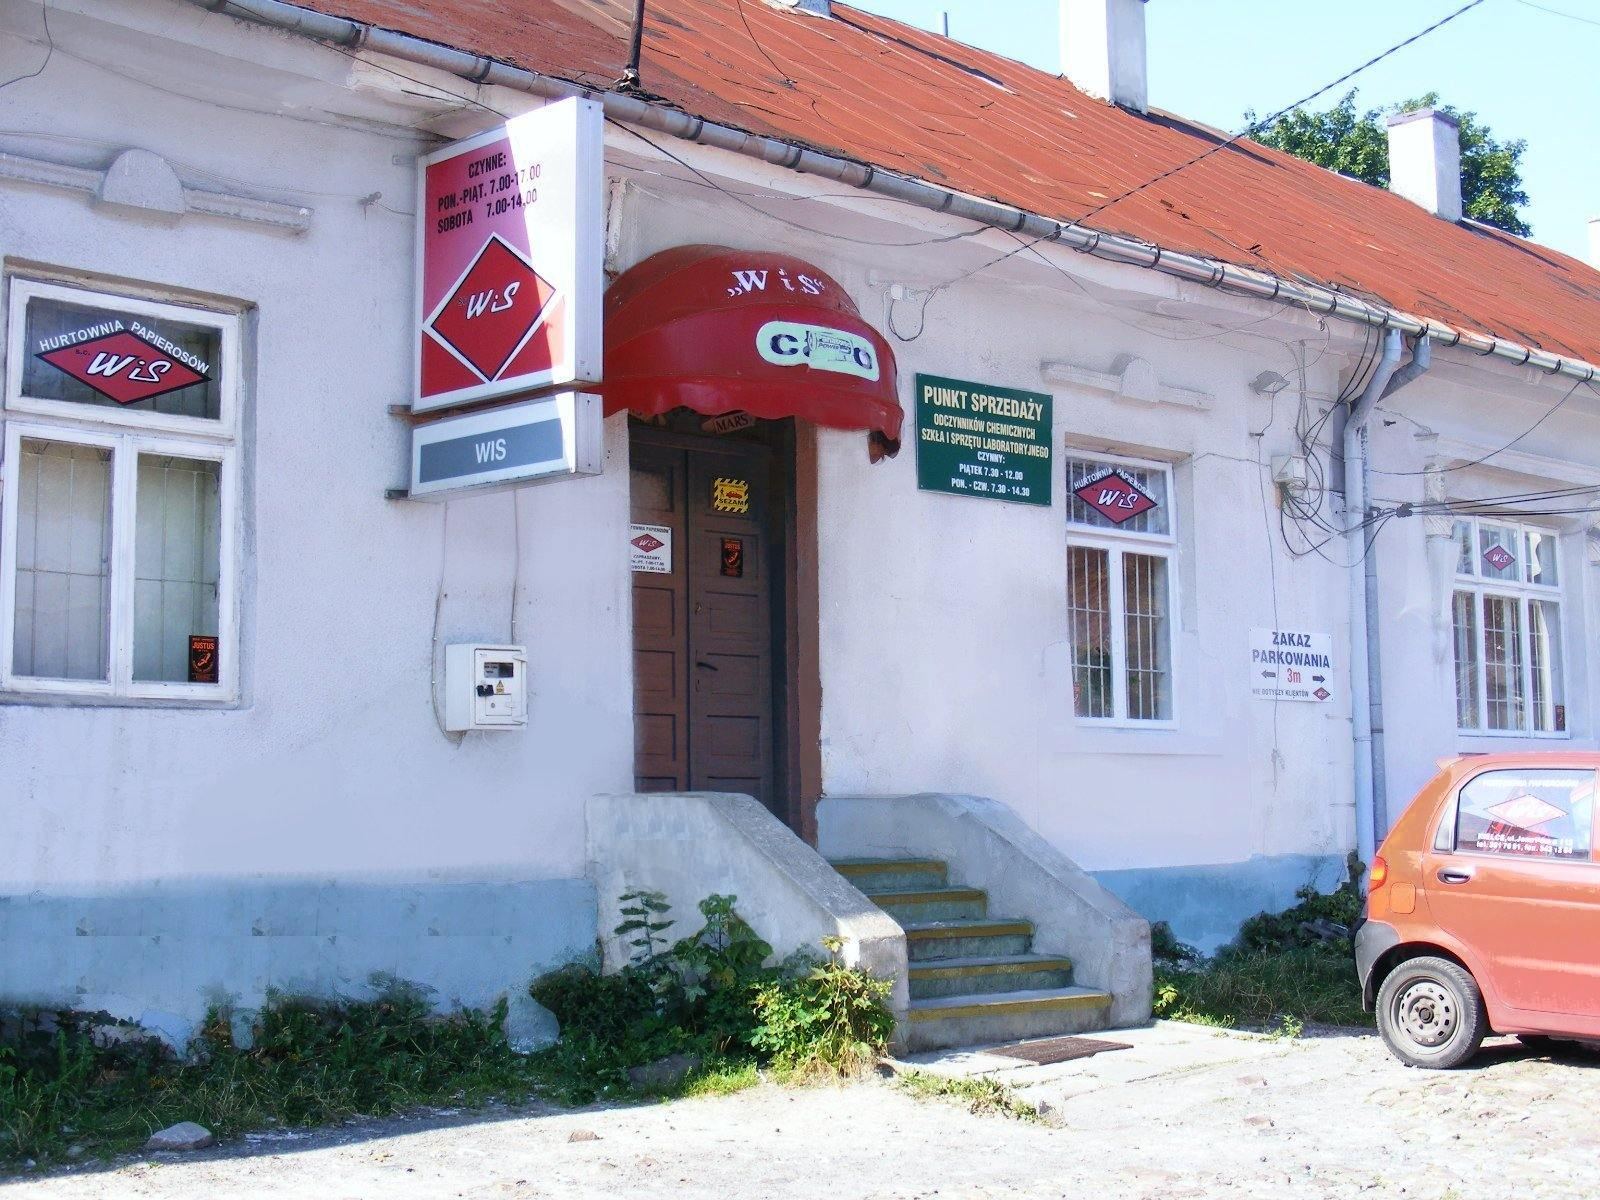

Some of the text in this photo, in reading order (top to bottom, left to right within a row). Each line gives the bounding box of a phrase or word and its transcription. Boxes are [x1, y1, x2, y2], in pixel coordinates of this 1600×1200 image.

[468, 152, 507, 178] CZYNNE:
[438, 183, 487, 212] PON.-PIĄT.
[437, 188, 538, 234] SOBOTA 7.00-14.00
[466, 281, 521, 320] WiS
[39, 319, 210, 373] HURTOWNIA PAPIEROSÓW
[86, 352, 172, 384] WiS
[923, 385, 1043, 422] PUNKT SPRZEDAŻY
[715, 413, 749, 432] MARS
[933, 413, 1036, 440] ODCZYNNIKÓW CHEMICZNYCH
[475, 438, 507, 464] WIS
[921, 428, 1049, 459] SZKŁA I SPRZĘTU LABORATORYJNEGO
[977, 451, 1006, 464] CZYNNY:
[959, 463, 983, 476] PIĄTEK
[984, 467, 999, 478] 7.30
[1004, 470, 1024, 481] 12.00
[1073, 467, 1157, 502] HURTOWNIA PAPIEROSÓW
[951, 477, 968, 489] PON.
[973, 481, 990, 492] CZW.
[991, 483, 1006, 494] 7.30
[1011, 486, 1030, 497] 14.30
[1098, 489, 1139, 510] WiS
[719, 498, 744, 506] SEZAM
[192, 641, 215, 650] JUSTUS
[1272, 631, 1311, 648] ZAKAZ
[1252, 649, 1330, 669] PARKOWANIA
[1286, 668, 1302, 683] 3m
